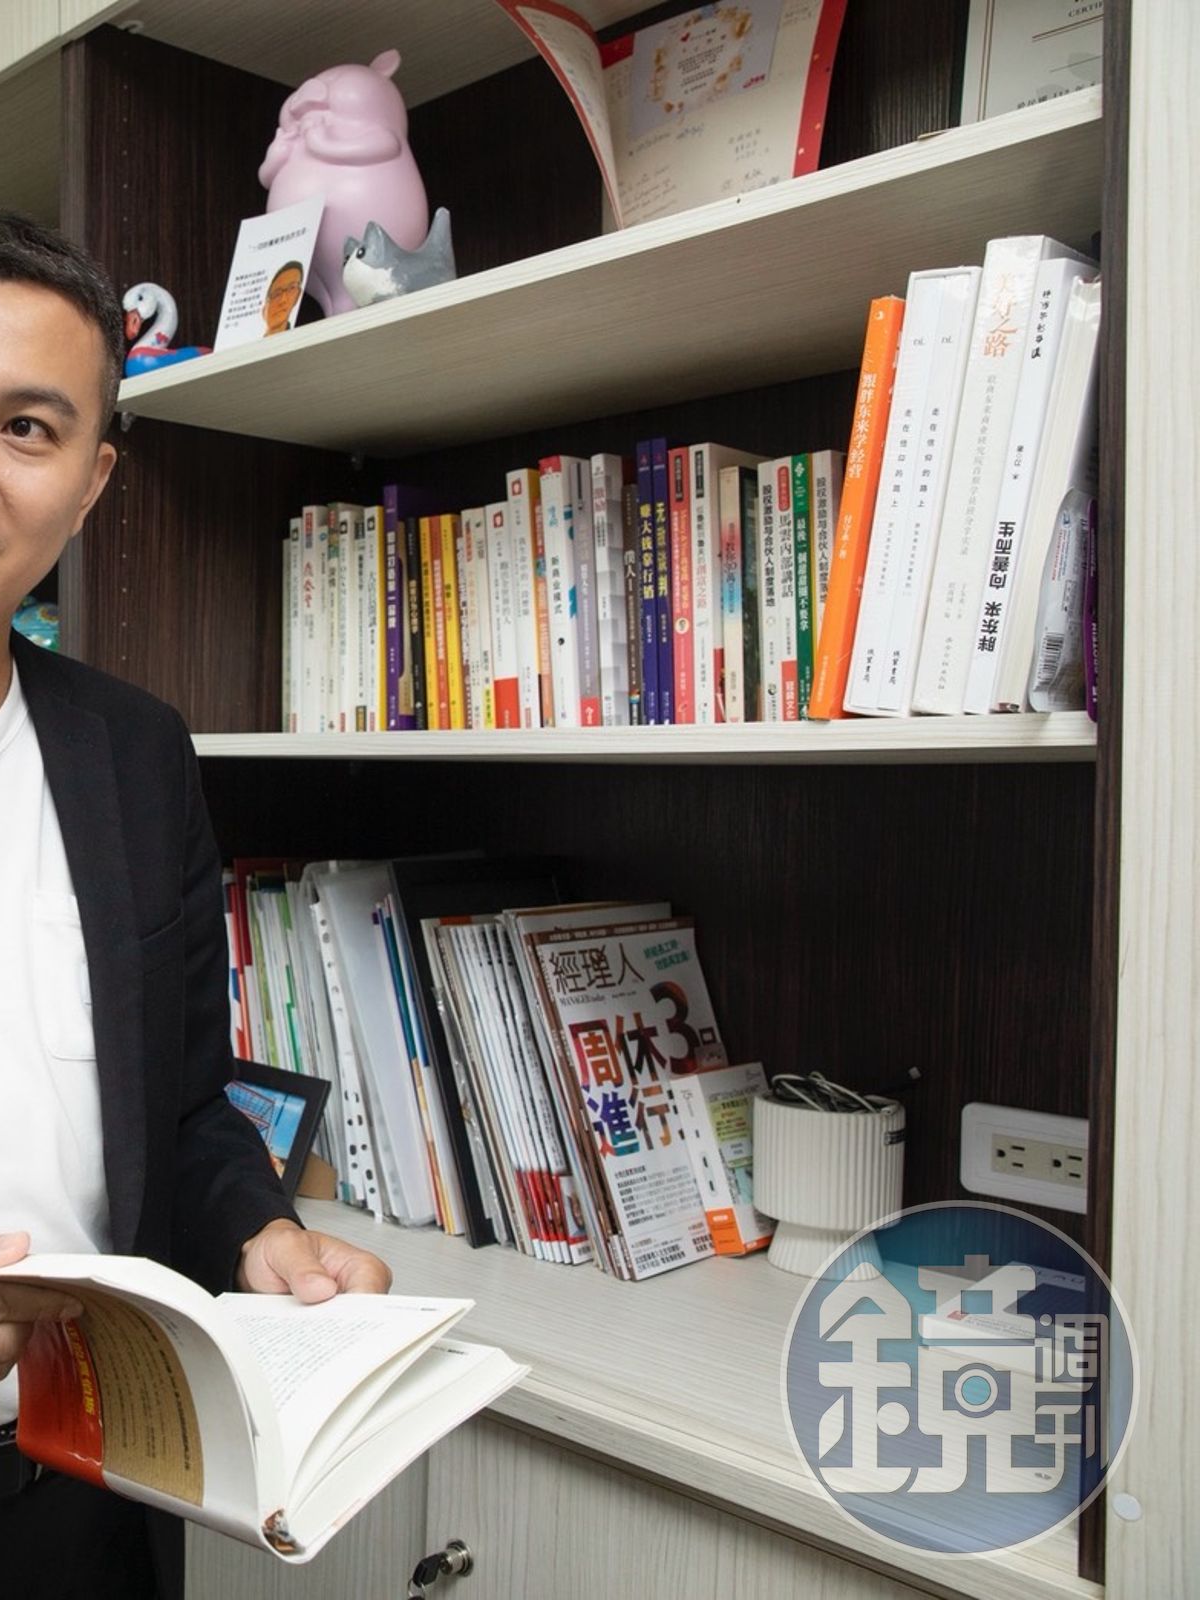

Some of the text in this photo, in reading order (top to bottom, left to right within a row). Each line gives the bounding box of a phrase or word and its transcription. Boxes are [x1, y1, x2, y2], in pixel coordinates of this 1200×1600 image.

[848, 373, 877, 479] 跟胖东来学经营
[890, 408, 912, 508] 走在信仰的路上
[917, 407, 940, 508] 走在信仰的路上
[977, 520, 1016, 653] 胖东来 向善而生
[549, 942, 645, 995] 經理人
[585, 1084, 686, 1158] 進行
